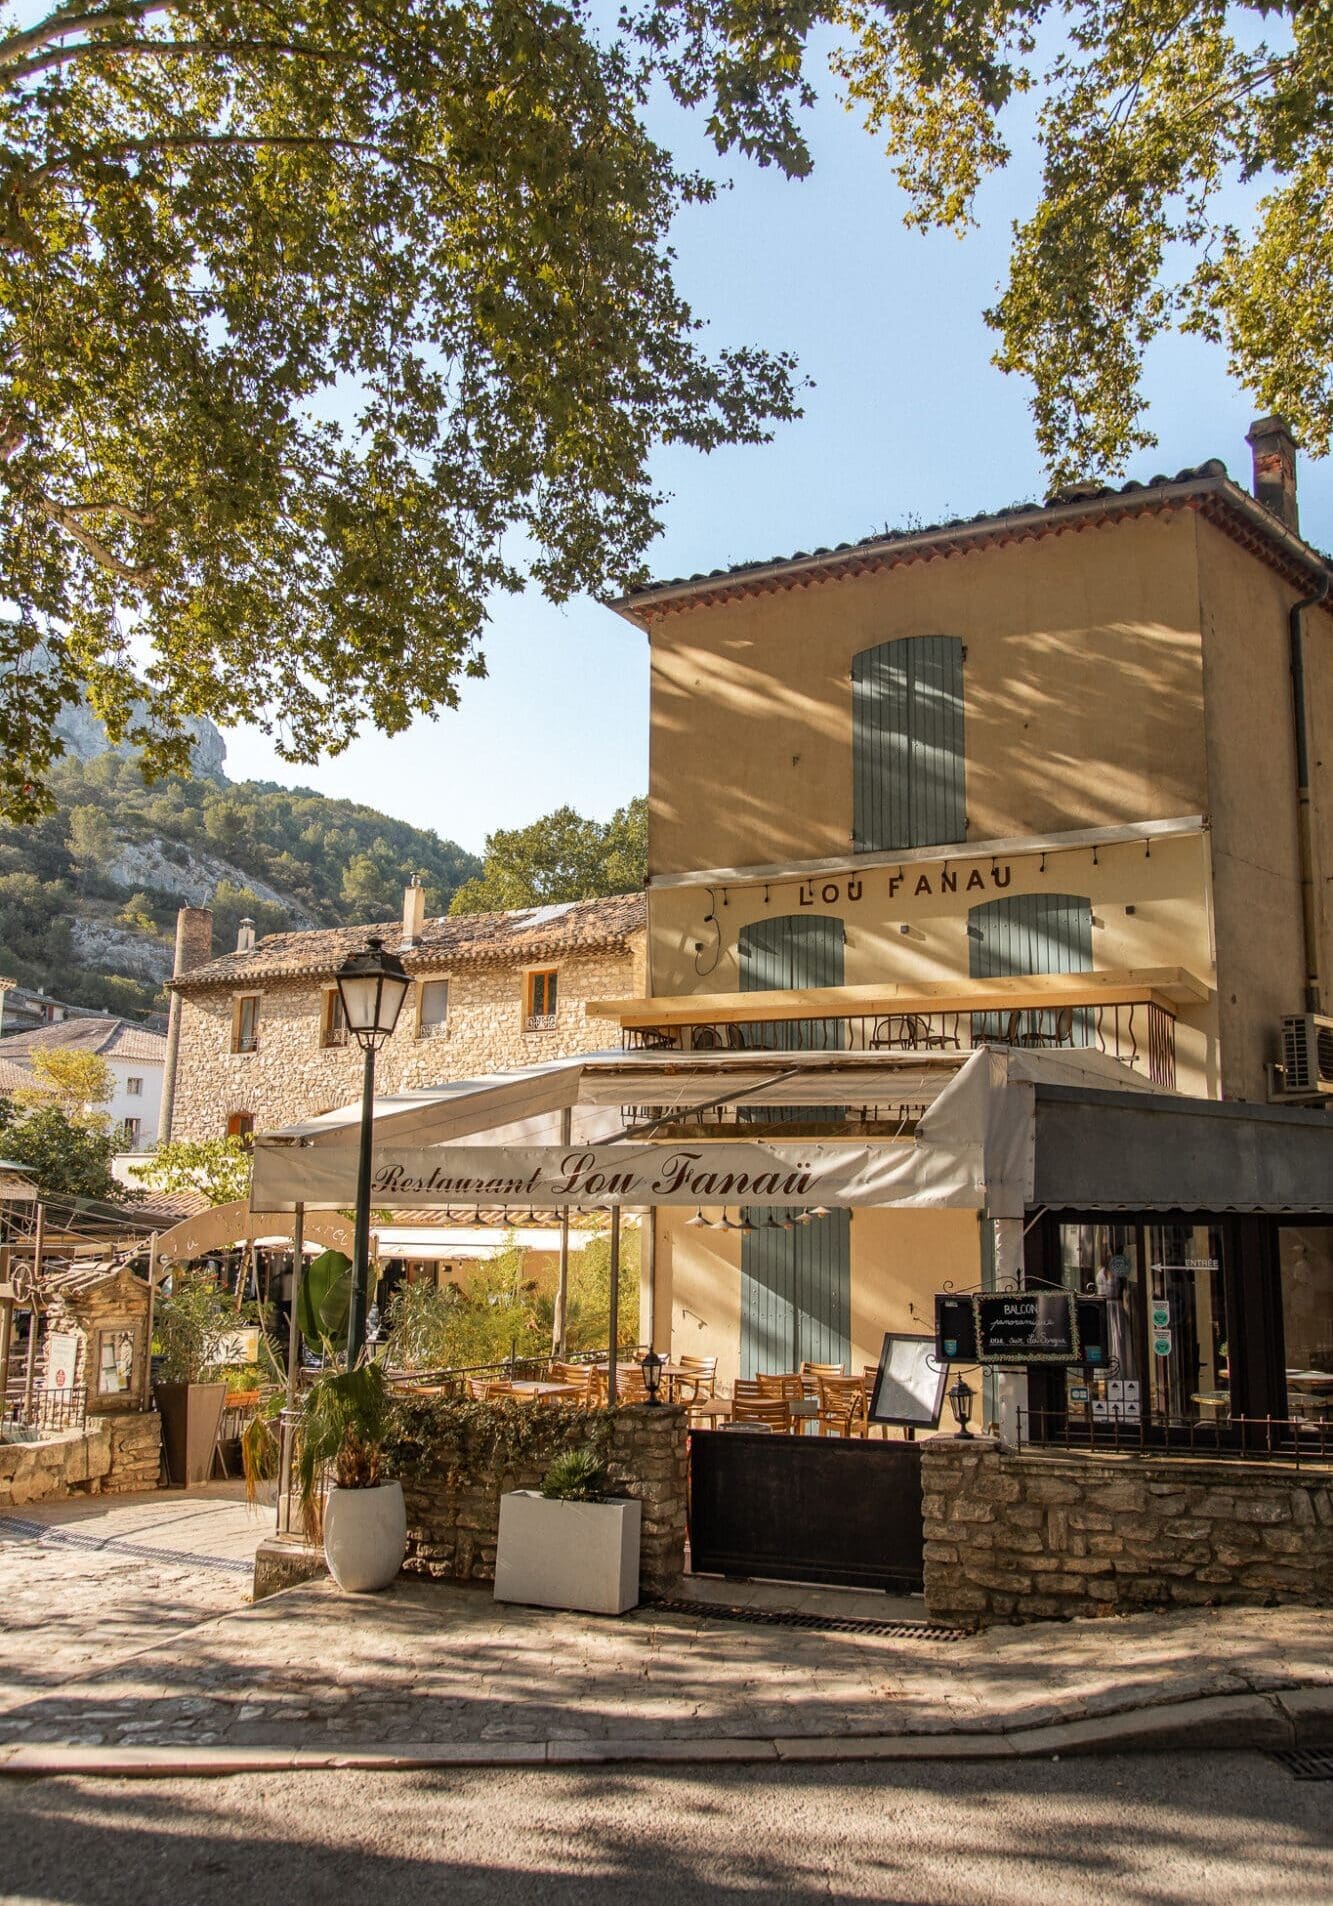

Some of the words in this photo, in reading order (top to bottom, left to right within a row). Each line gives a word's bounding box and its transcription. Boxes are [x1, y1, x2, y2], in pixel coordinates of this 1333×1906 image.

[799, 881, 863, 906] LOU
[888, 866, 1011, 898] FANAU
[371, 1164, 544, 1194] Restaurant
[550, 1152, 640, 1194] Lou
[652, 1152, 823, 1194] Fanaü
[1184, 1258, 1220, 1267] ENTRÉE
